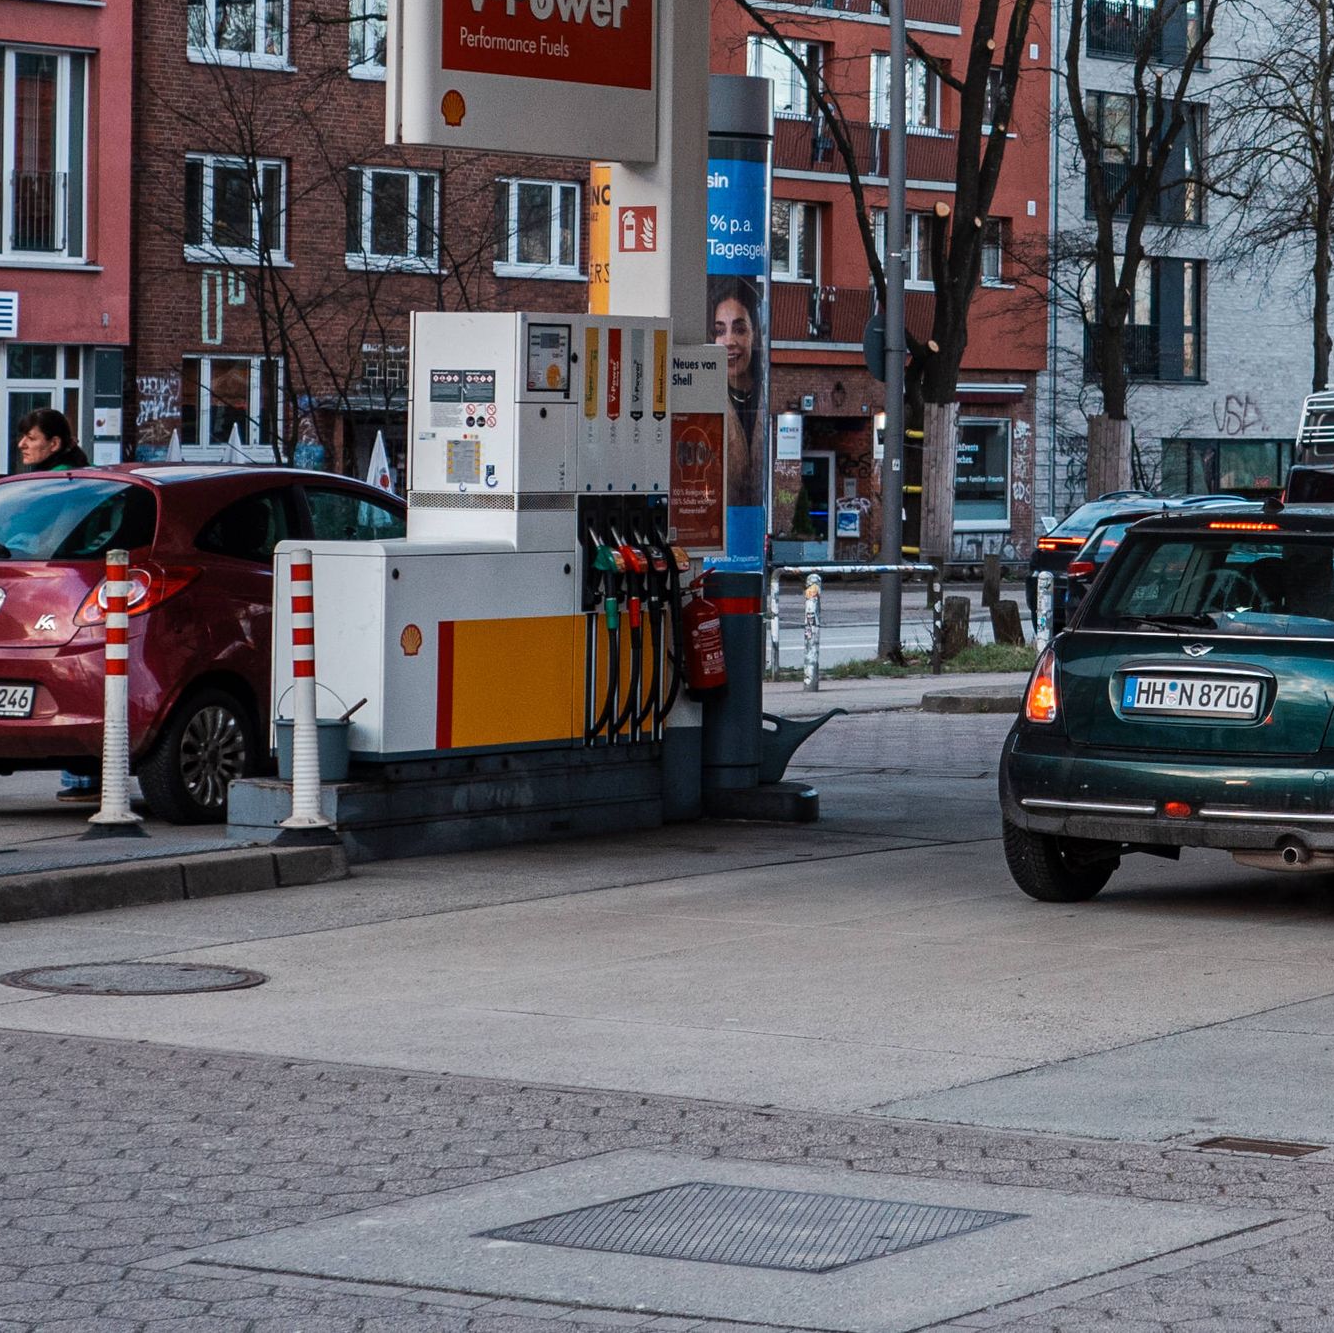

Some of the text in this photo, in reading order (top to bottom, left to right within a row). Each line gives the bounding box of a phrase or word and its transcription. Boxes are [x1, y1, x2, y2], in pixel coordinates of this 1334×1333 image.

[460, 26, 570, 57] Performance Fuels
[730, 219, 753, 235] p.a.
[672, 358, 717, 371] Neues von
[672, 373, 693, 386] Shell
[1137, 681, 1255, 709] HH N 8706
